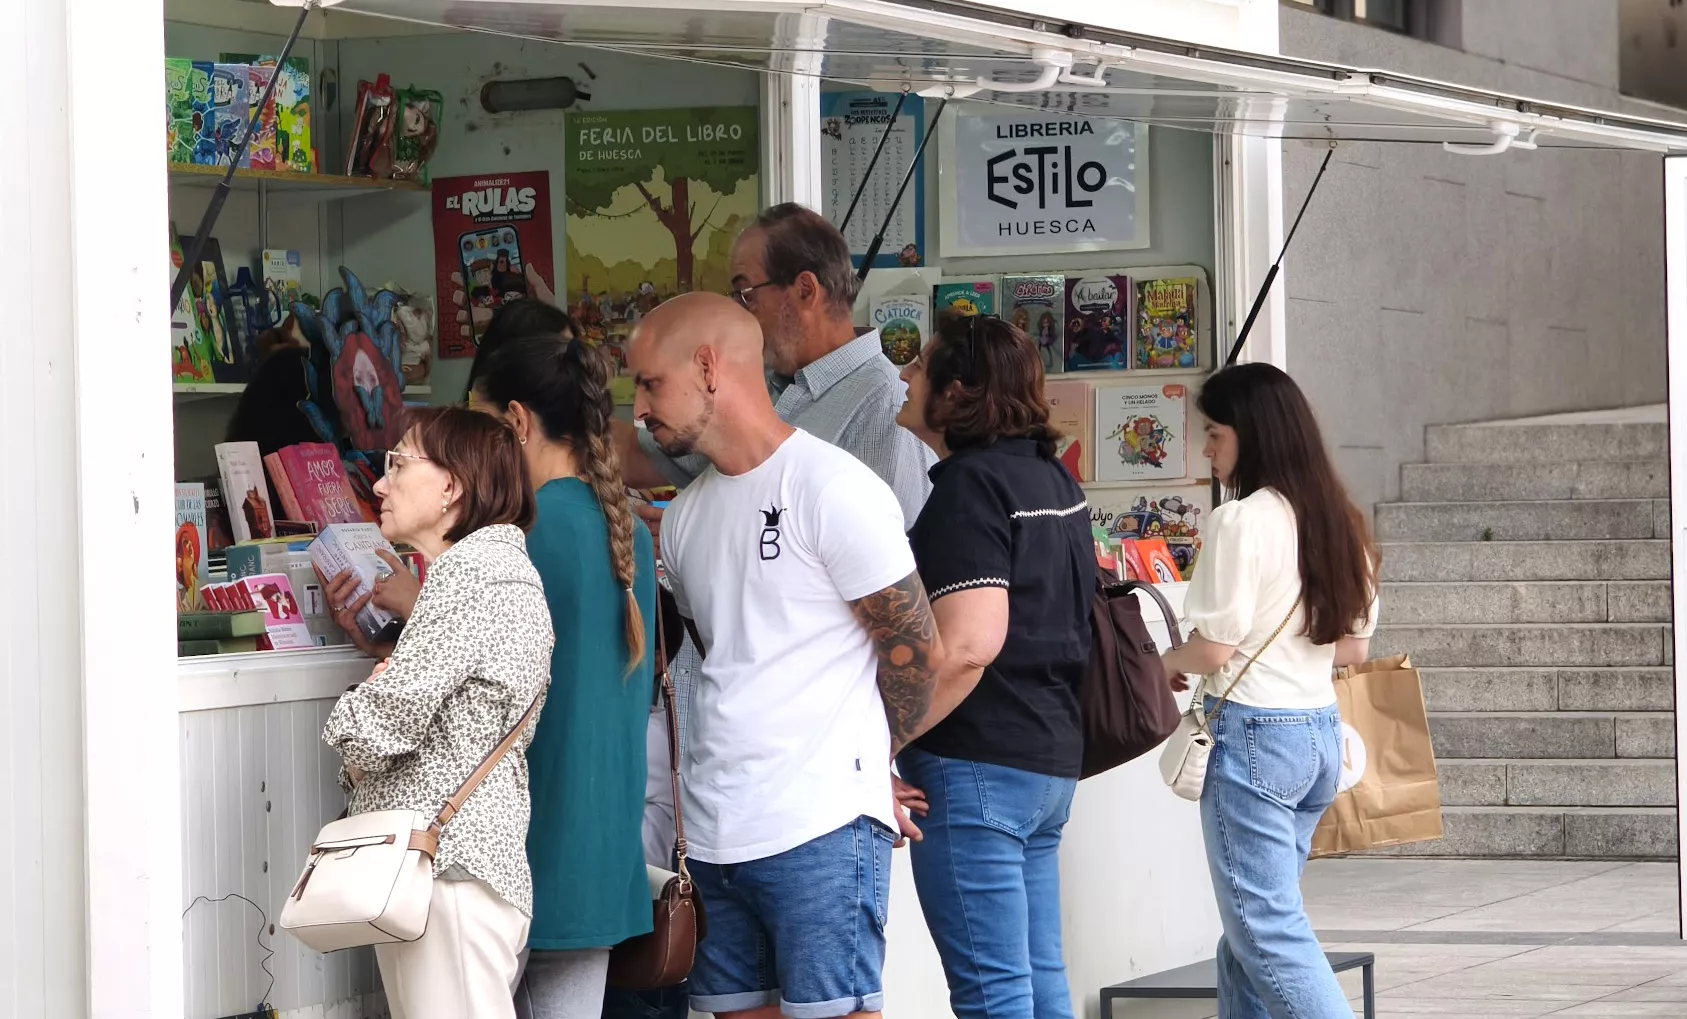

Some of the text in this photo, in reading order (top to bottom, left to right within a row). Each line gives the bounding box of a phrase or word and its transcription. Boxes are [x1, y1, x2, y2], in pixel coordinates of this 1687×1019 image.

[579, 124, 742, 146] FERIA DEL LIBRO
[996, 120, 1095, 139] LIBRERIA
[579, 149, 642, 161] DE HUESCA
[446, 187, 537, 217] EL RULAS
[999, 218, 1096, 236] HUESCA
[307, 459, 340, 482] AMOR
[318, 481, 343, 495] FUERA
[325, 496, 354, 517] SERIE
[760, 528, 780, 560] B
